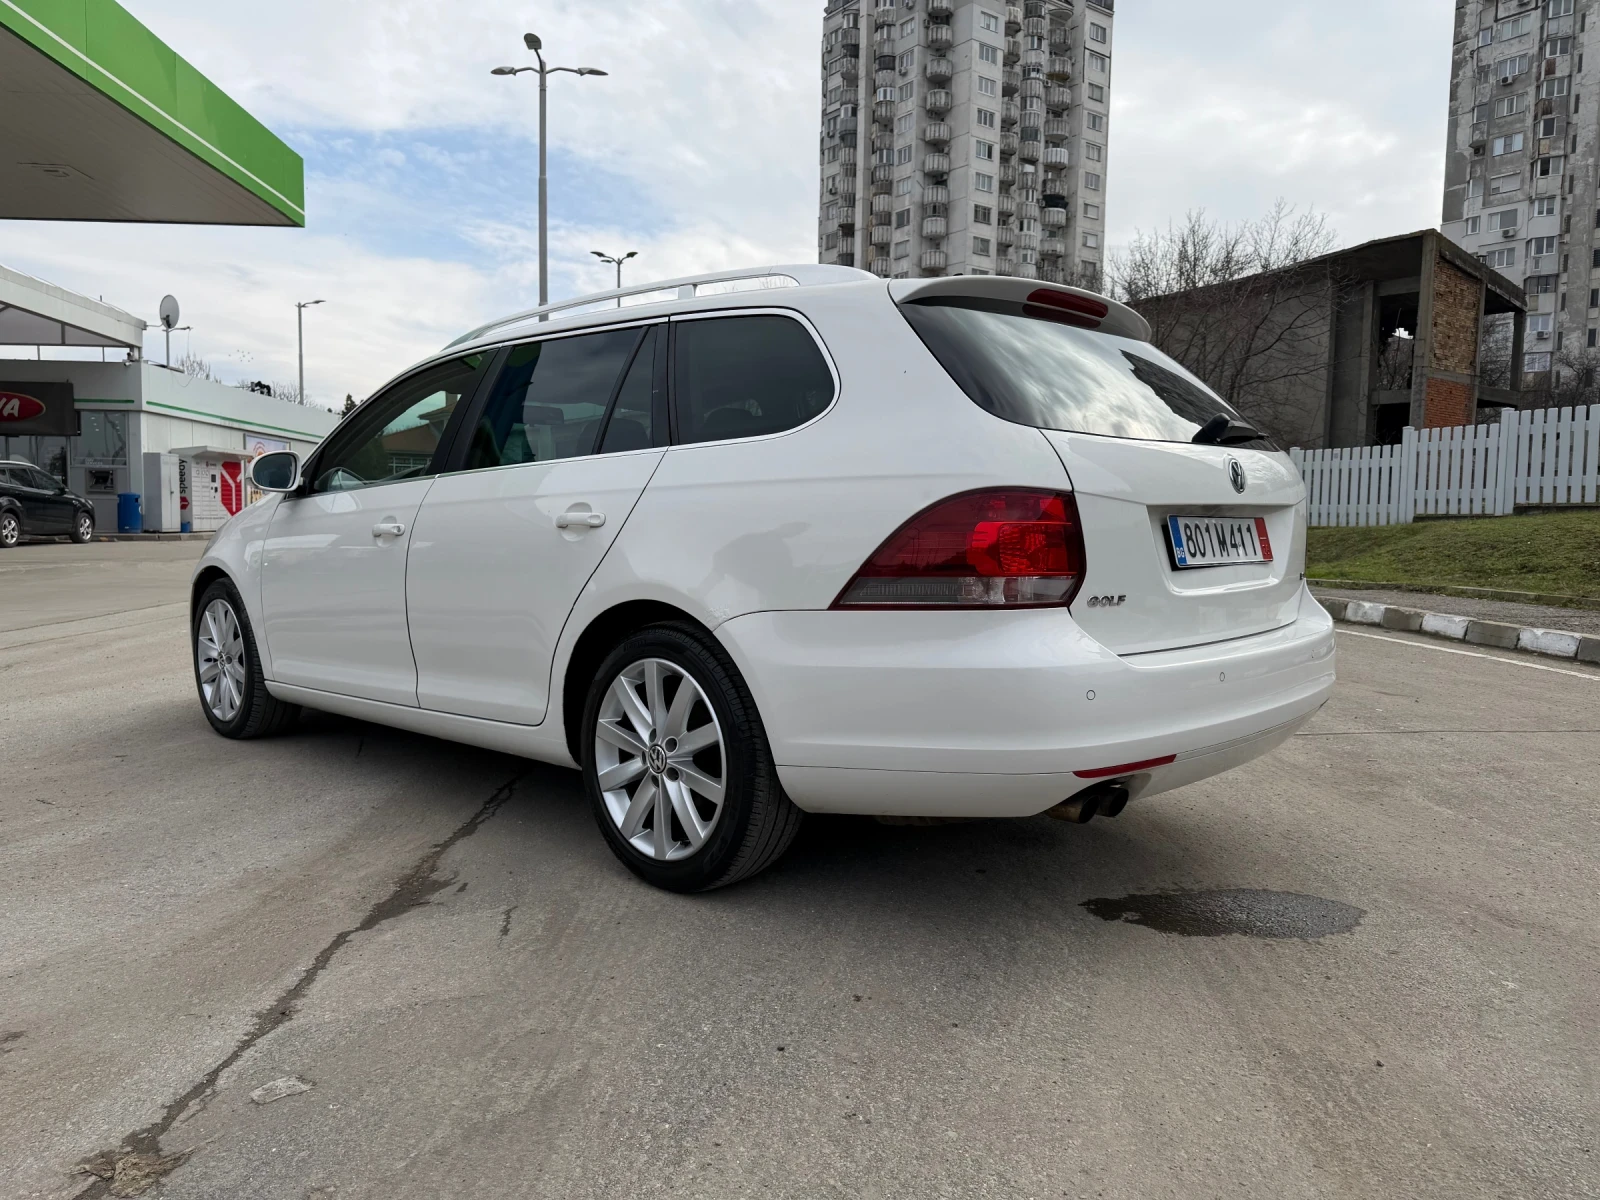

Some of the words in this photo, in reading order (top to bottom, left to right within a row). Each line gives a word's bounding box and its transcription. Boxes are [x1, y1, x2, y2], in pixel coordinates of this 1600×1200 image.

[1183, 522, 1257, 558] 801M411
[1176, 547, 1185, 559] BG
[1087, 594, 1127, 608] GOLF
